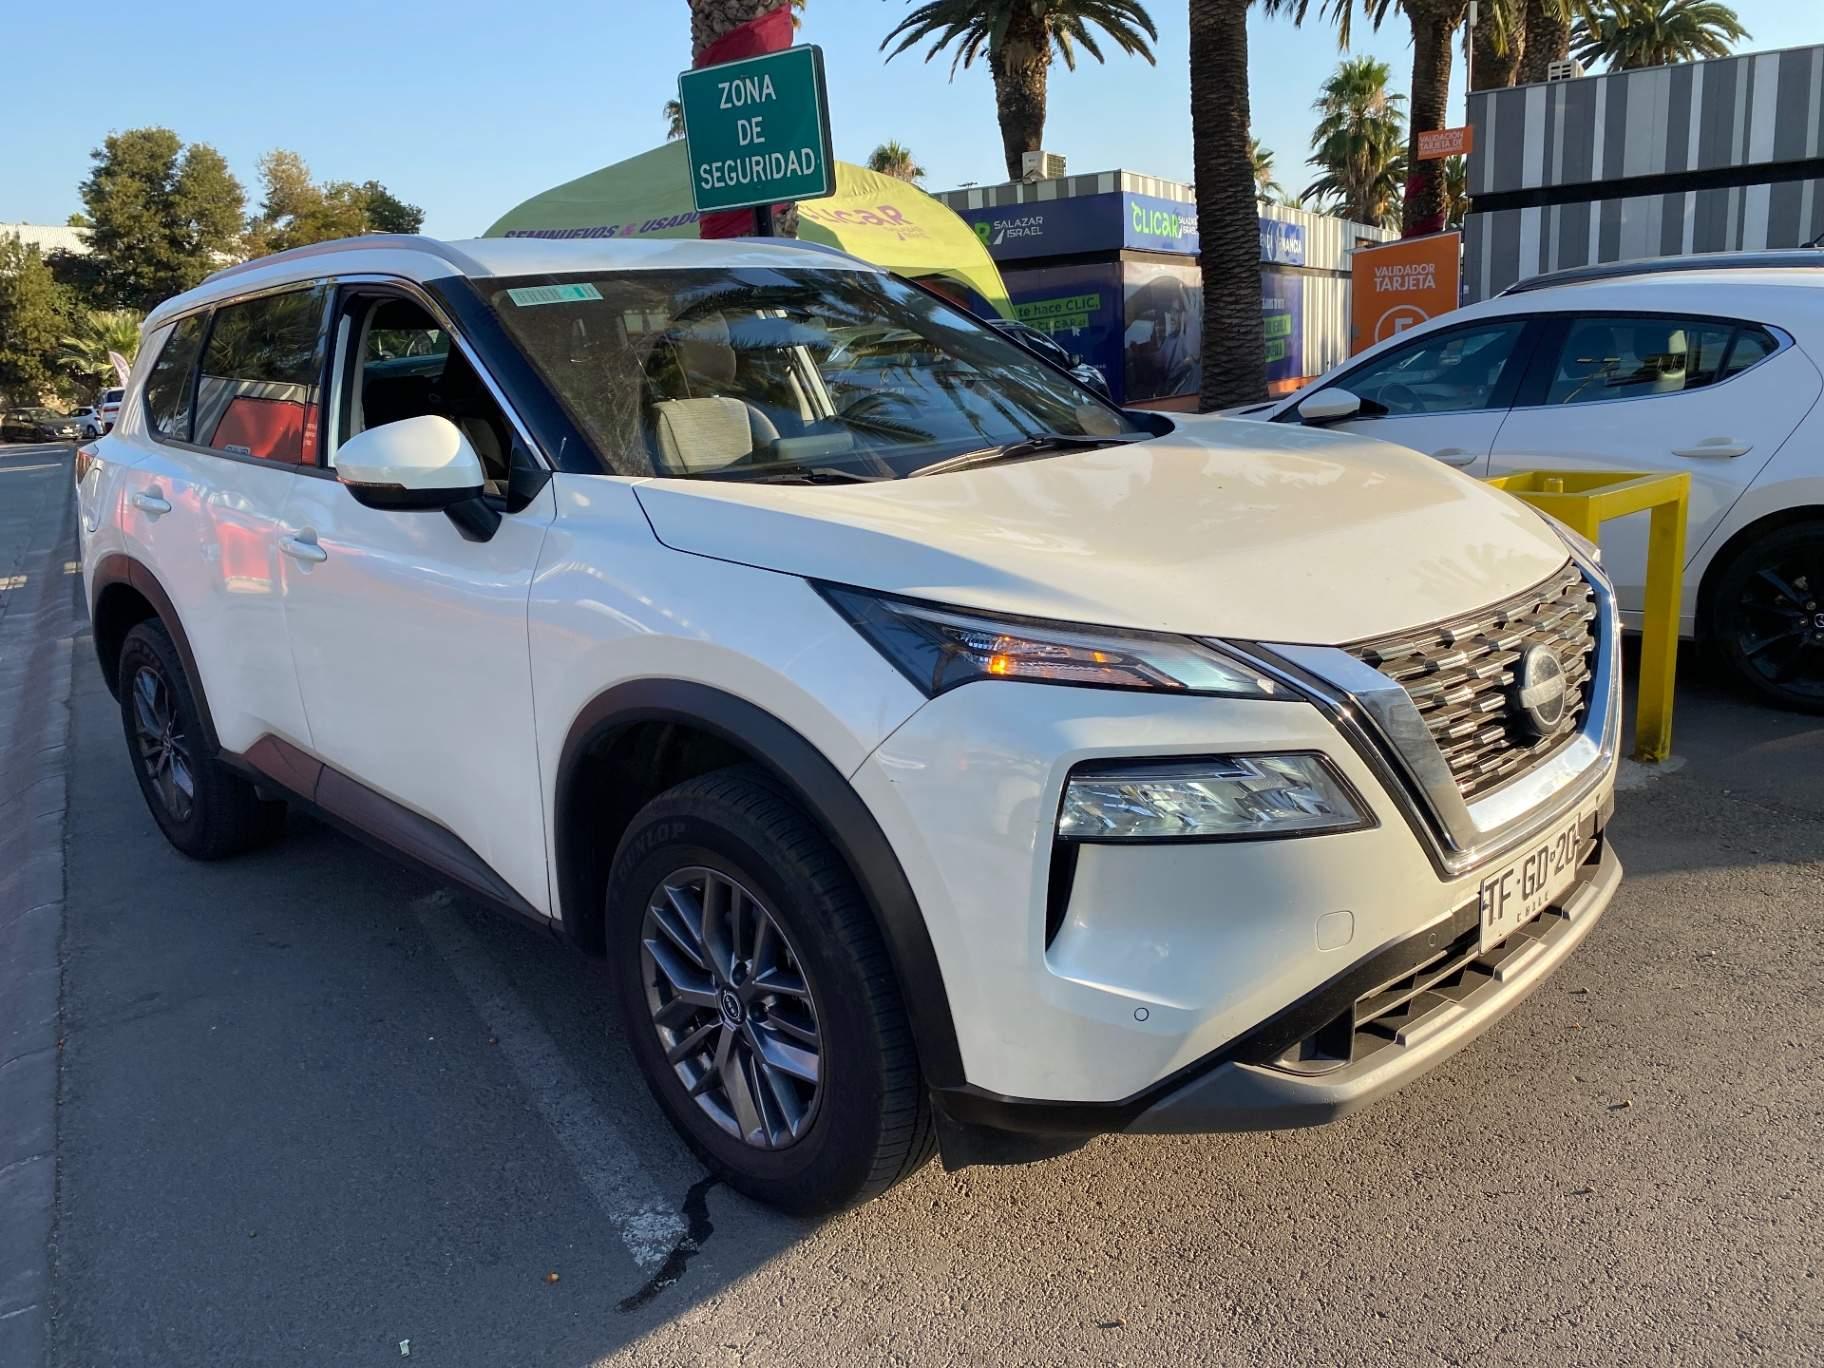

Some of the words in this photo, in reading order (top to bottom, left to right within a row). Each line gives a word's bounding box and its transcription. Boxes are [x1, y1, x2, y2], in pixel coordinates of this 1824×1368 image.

[718, 74, 776, 109] ZONA
[738, 116, 765, 146] DE
[700, 147, 815, 189] SEGURIDAD
[994, 216, 1043, 229] SALAZAR
[1007, 227, 1043, 238] ISRAEL
[1375, 264, 1435, 276] VALIDADOR
[1374, 274, 1436, 292] TARJETA
[1034, 303, 1062, 315] hace
